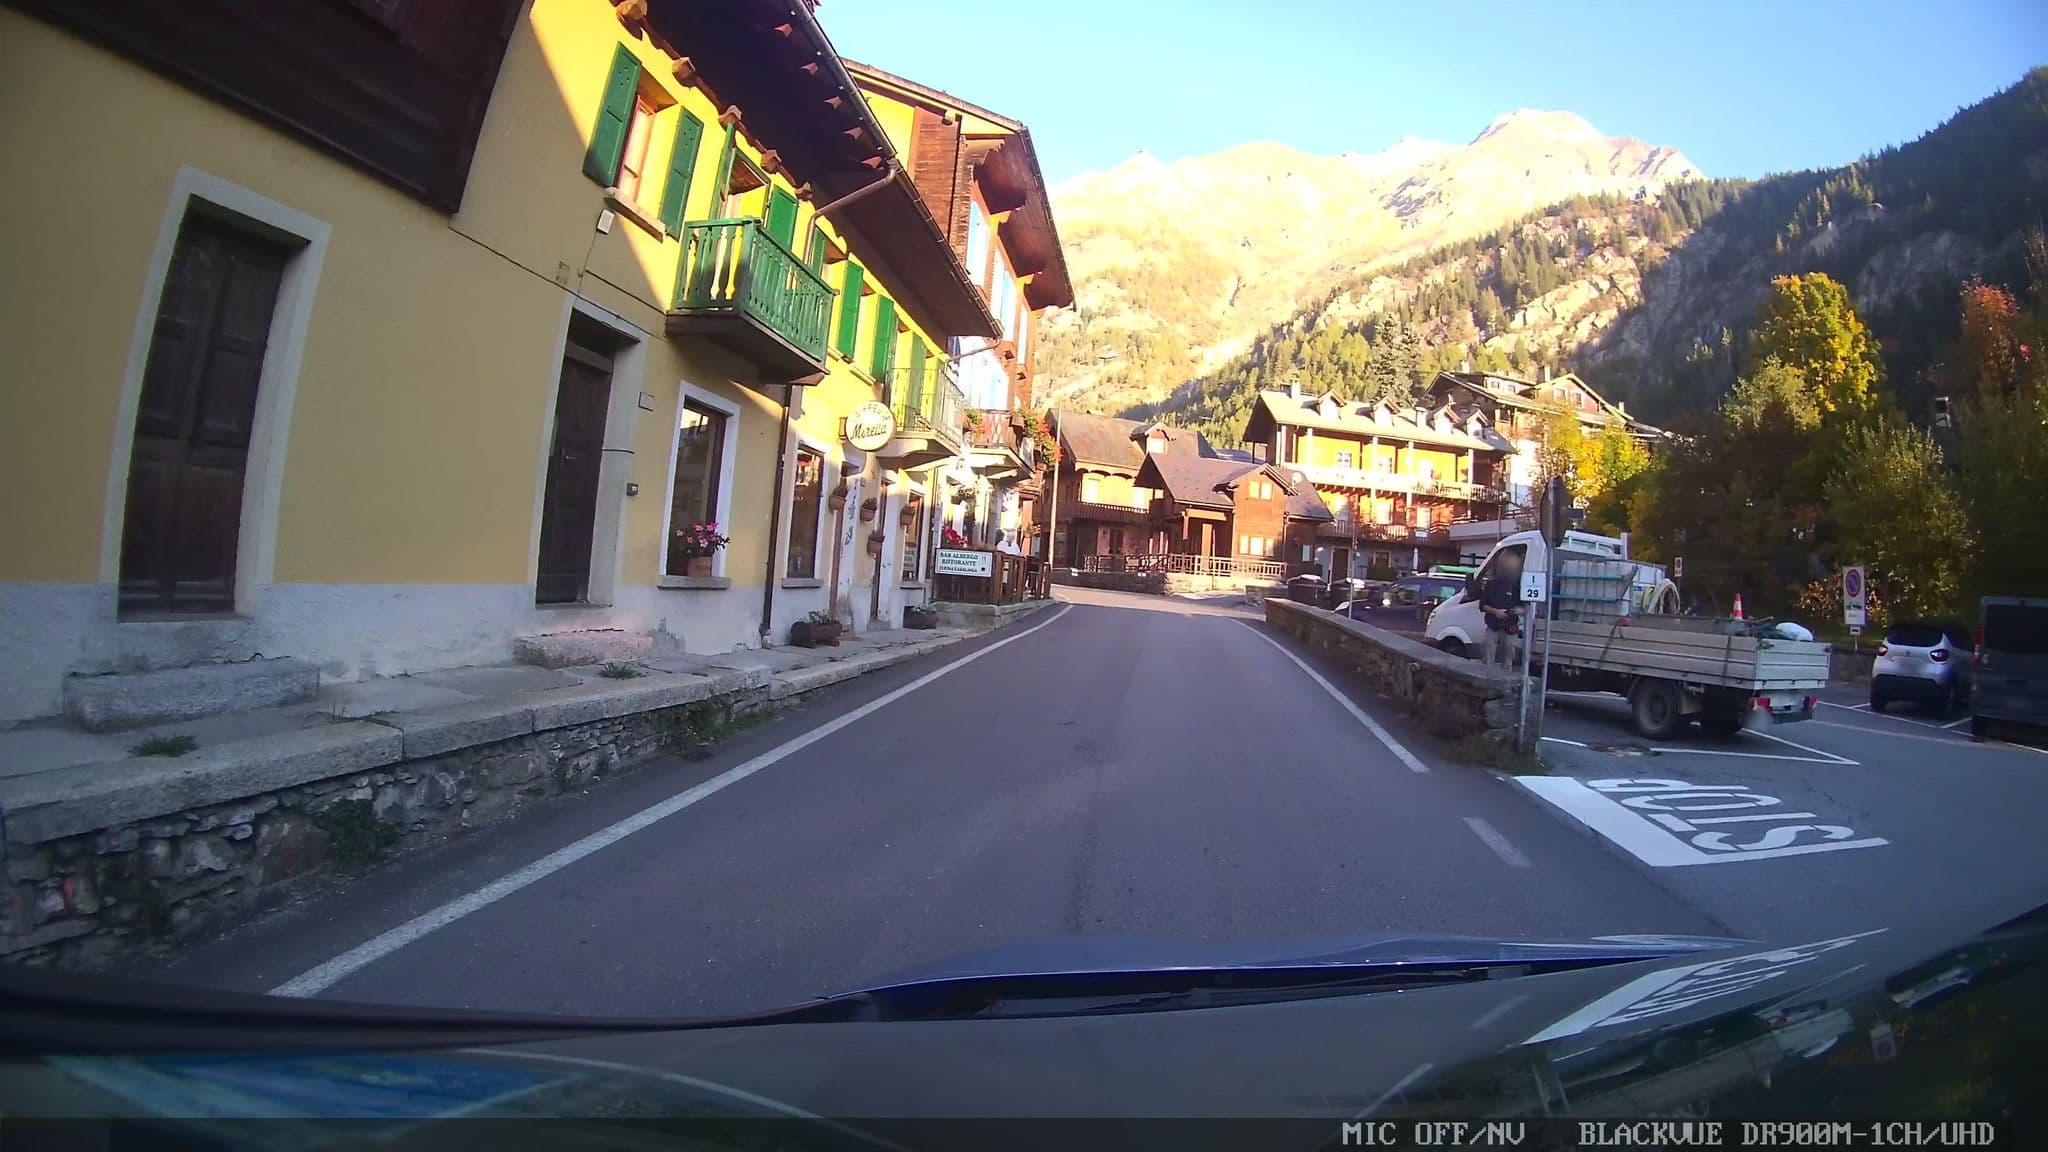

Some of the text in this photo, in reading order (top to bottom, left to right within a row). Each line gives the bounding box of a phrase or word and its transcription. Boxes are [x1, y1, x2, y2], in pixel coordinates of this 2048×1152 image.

[952, 552, 979, 560] ALBERGO
[941, 558, 977, 567] RISTORANTE
[1527, 589, 1539, 598] 29
[1586, 777, 1855, 852] STOP
